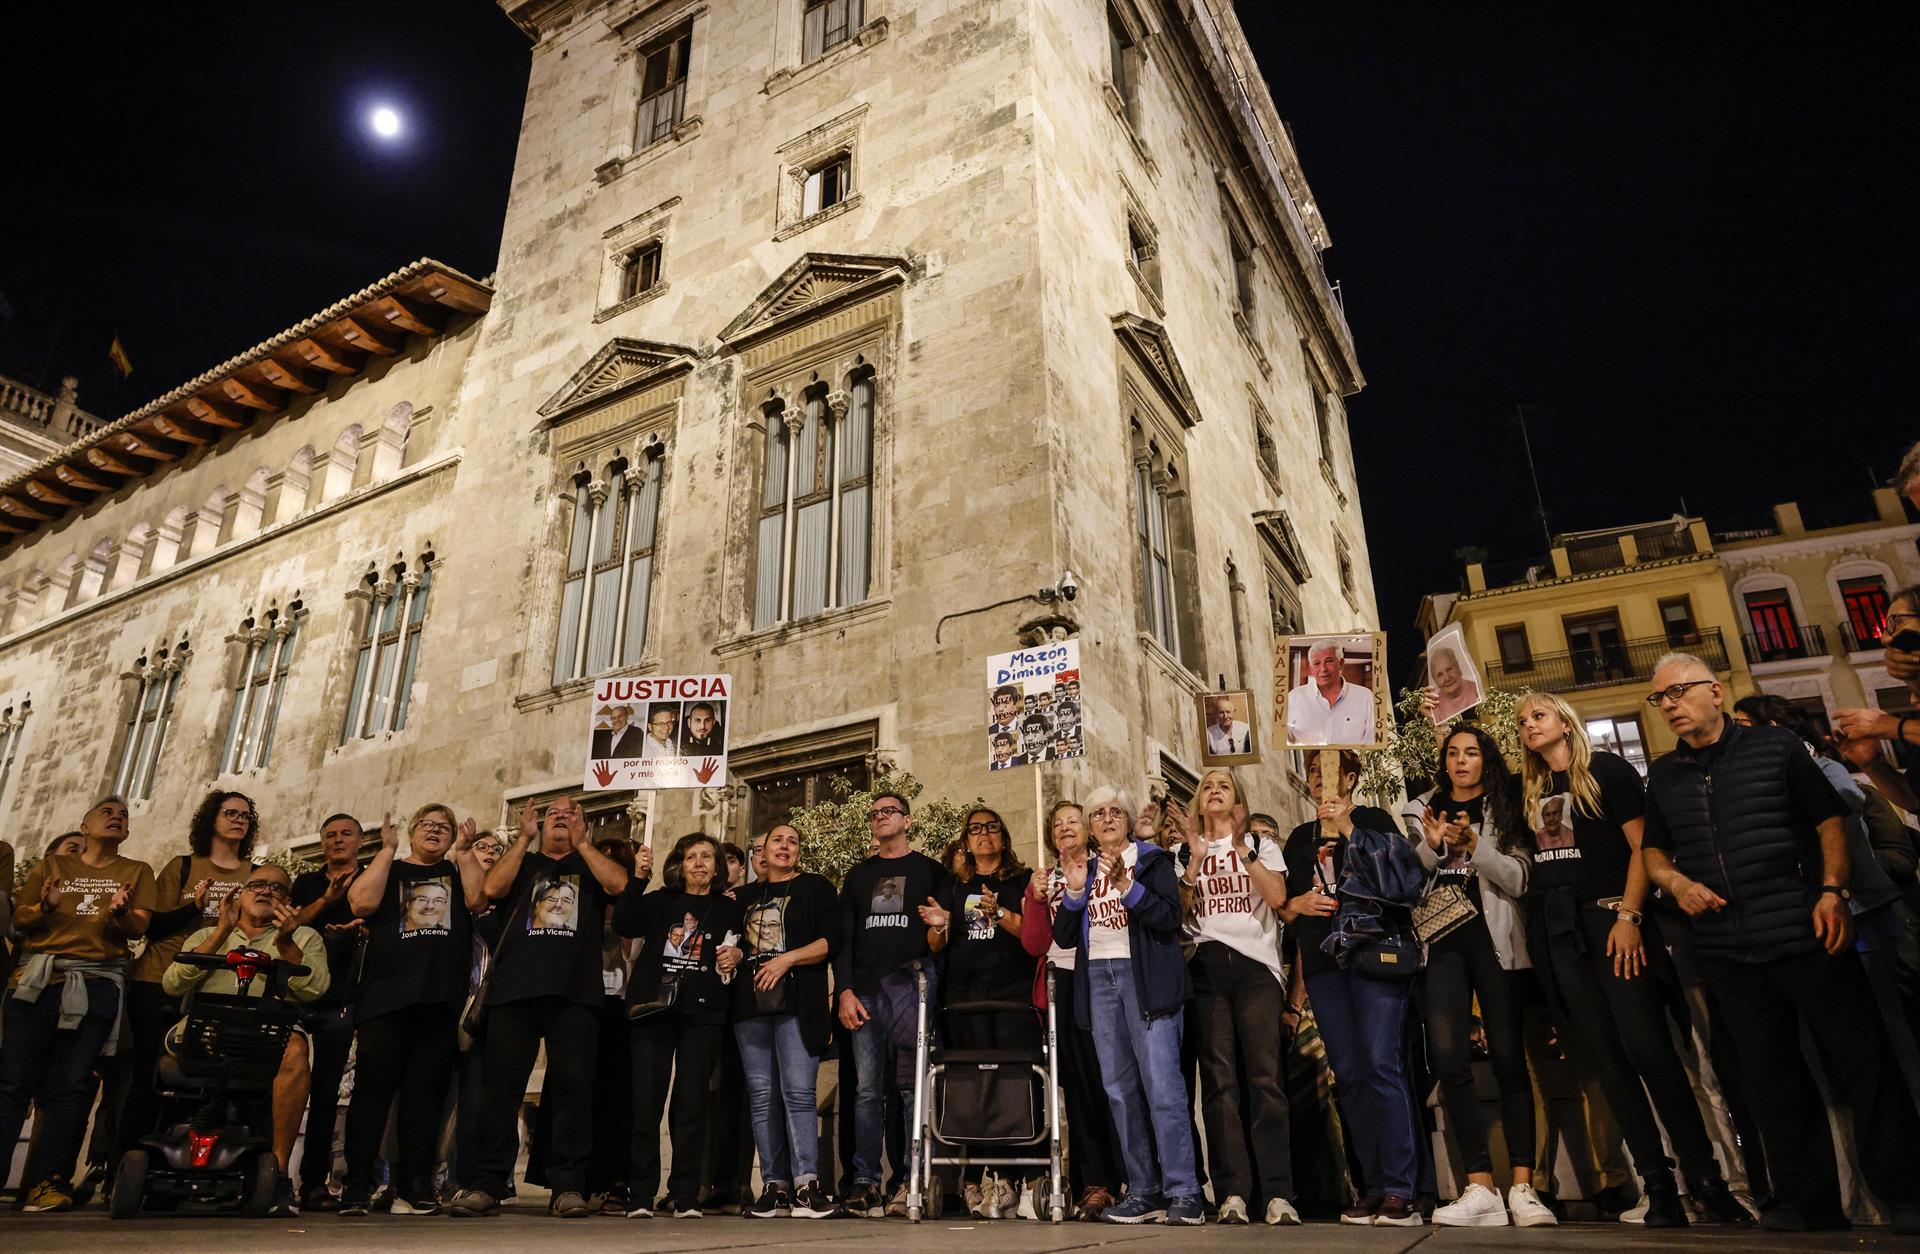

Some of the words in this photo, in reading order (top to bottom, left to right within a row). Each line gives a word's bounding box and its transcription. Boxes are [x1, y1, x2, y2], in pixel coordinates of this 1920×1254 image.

[1274, 644, 1286, 722] MAZÓN
[597, 677, 727, 702] JUSTICIA
[623, 760, 640, 769] por
[642, 758, 653, 767] mi
[630, 771, 638, 780] y
[638, 769, 654, 778] mis
[1555, 848, 1582, 859] LUISA
[865, 914, 909, 930] MANOLO
[401, 929, 418, 939] José
[419, 928, 449, 937] Vicente
[528, 928, 544, 937] José
[546, 928, 574, 937] Vicente
